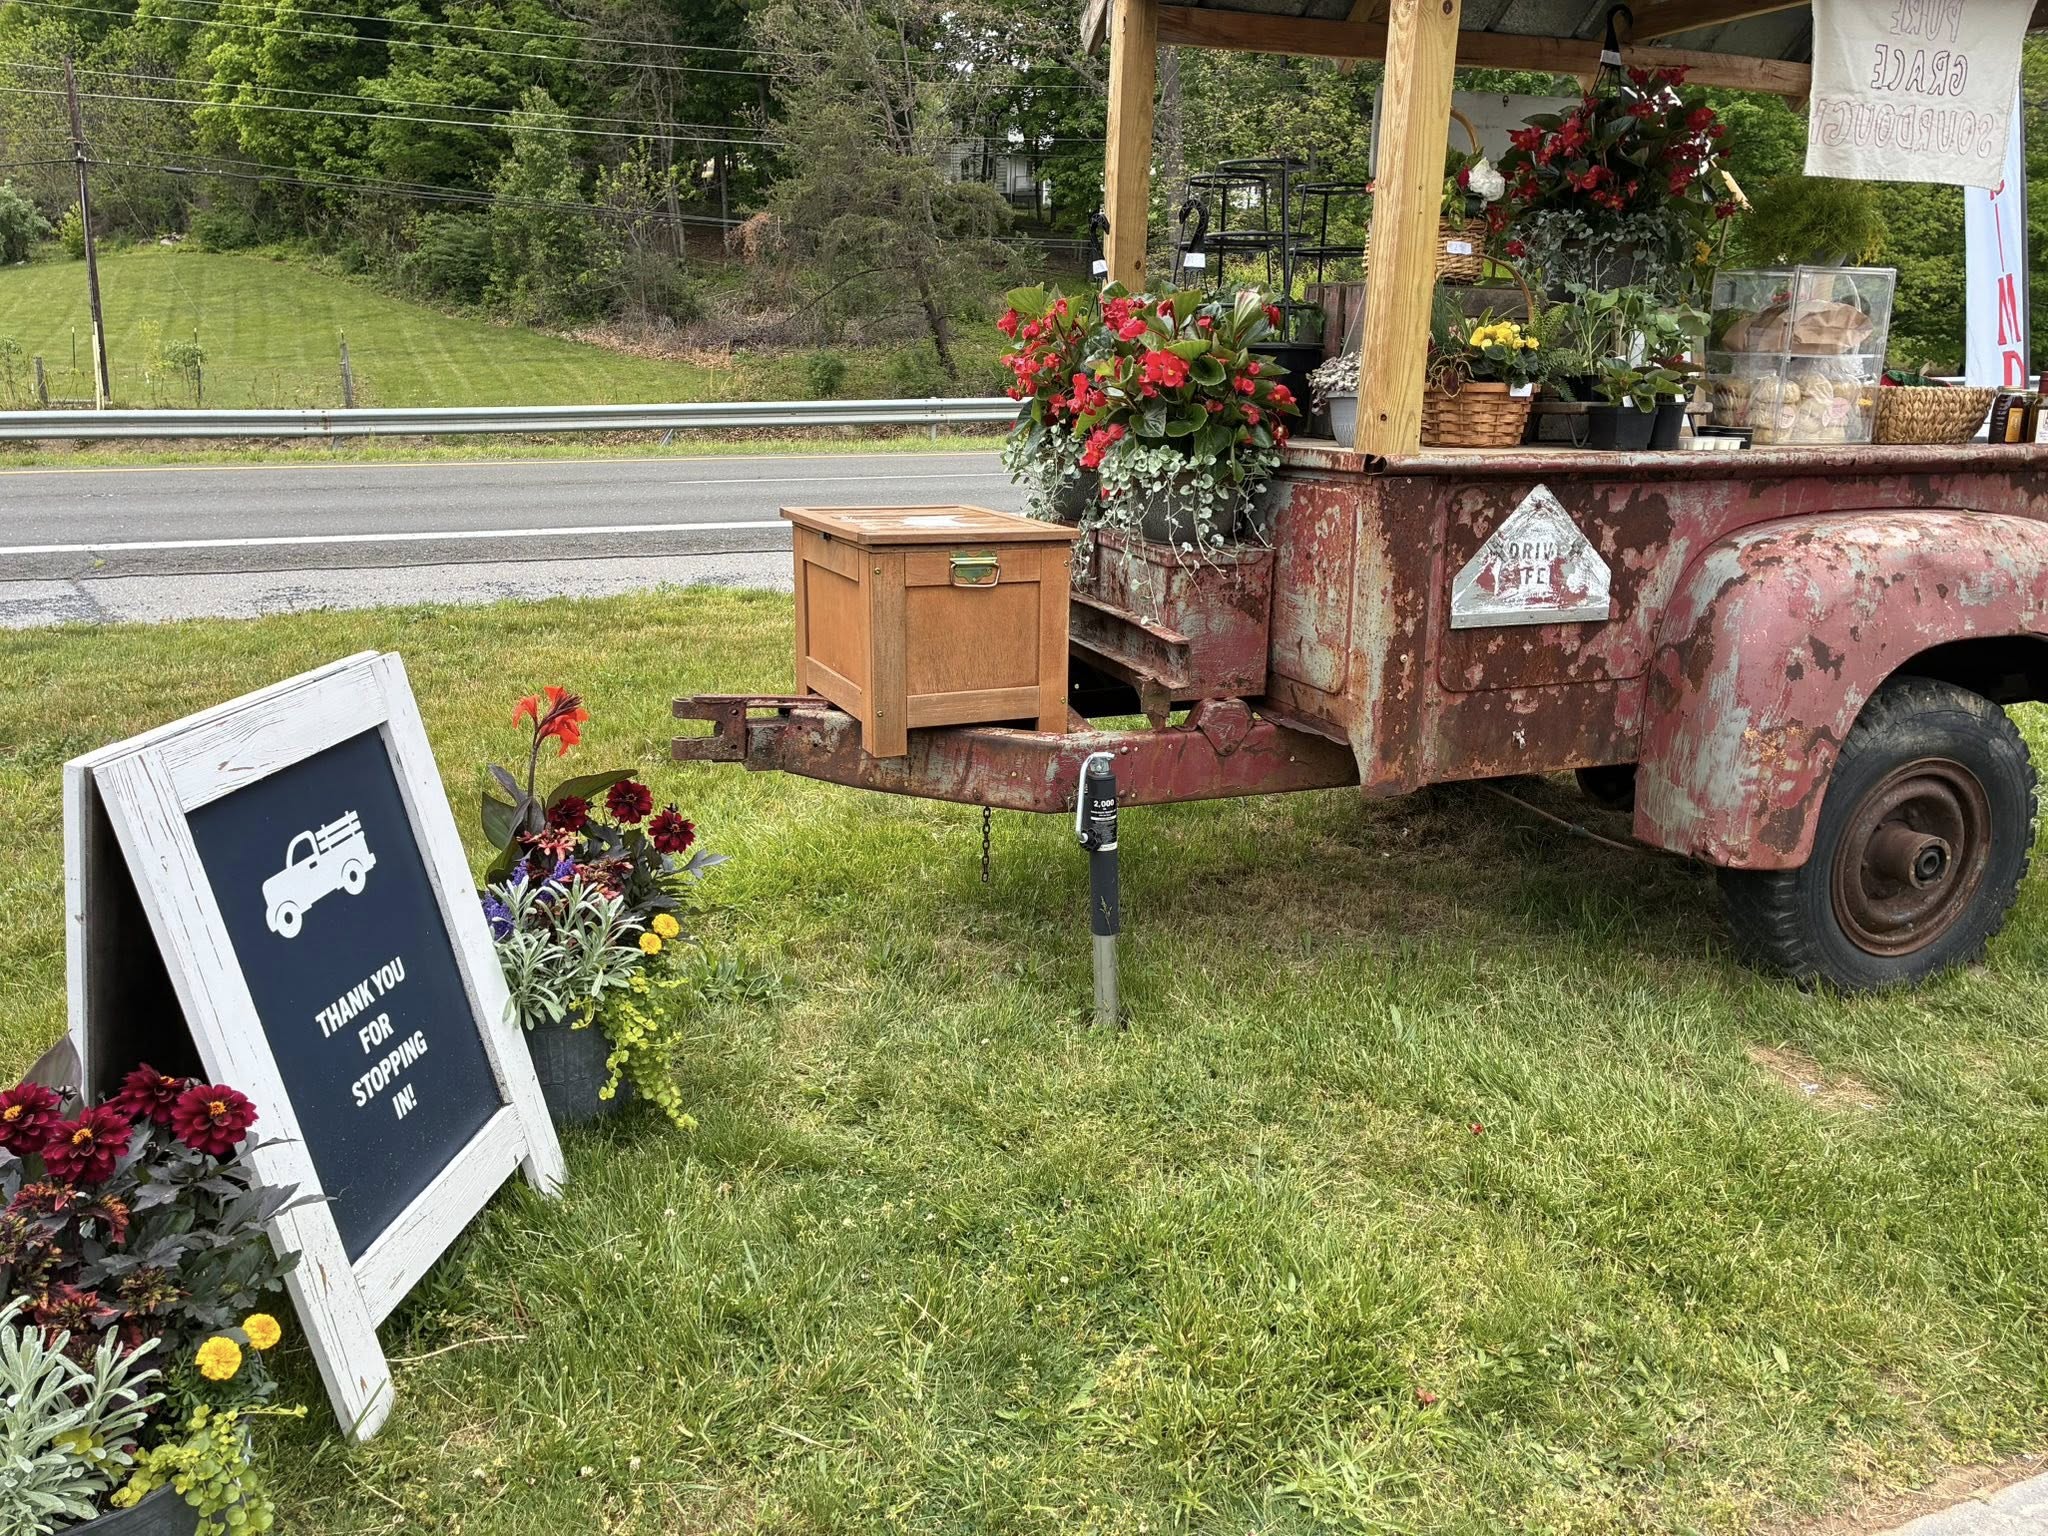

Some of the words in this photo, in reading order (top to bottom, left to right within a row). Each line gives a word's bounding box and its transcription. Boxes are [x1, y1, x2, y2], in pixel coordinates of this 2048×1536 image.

[1093, 799, 1114, 808] 2,000
[315, 979, 375, 1038] THANK
[370, 956, 406, 996] YOU
[358, 1012, 395, 1055] FOR
[352, 1030, 428, 1107] STOPPING
[392, 1083, 418, 1120] IN!
